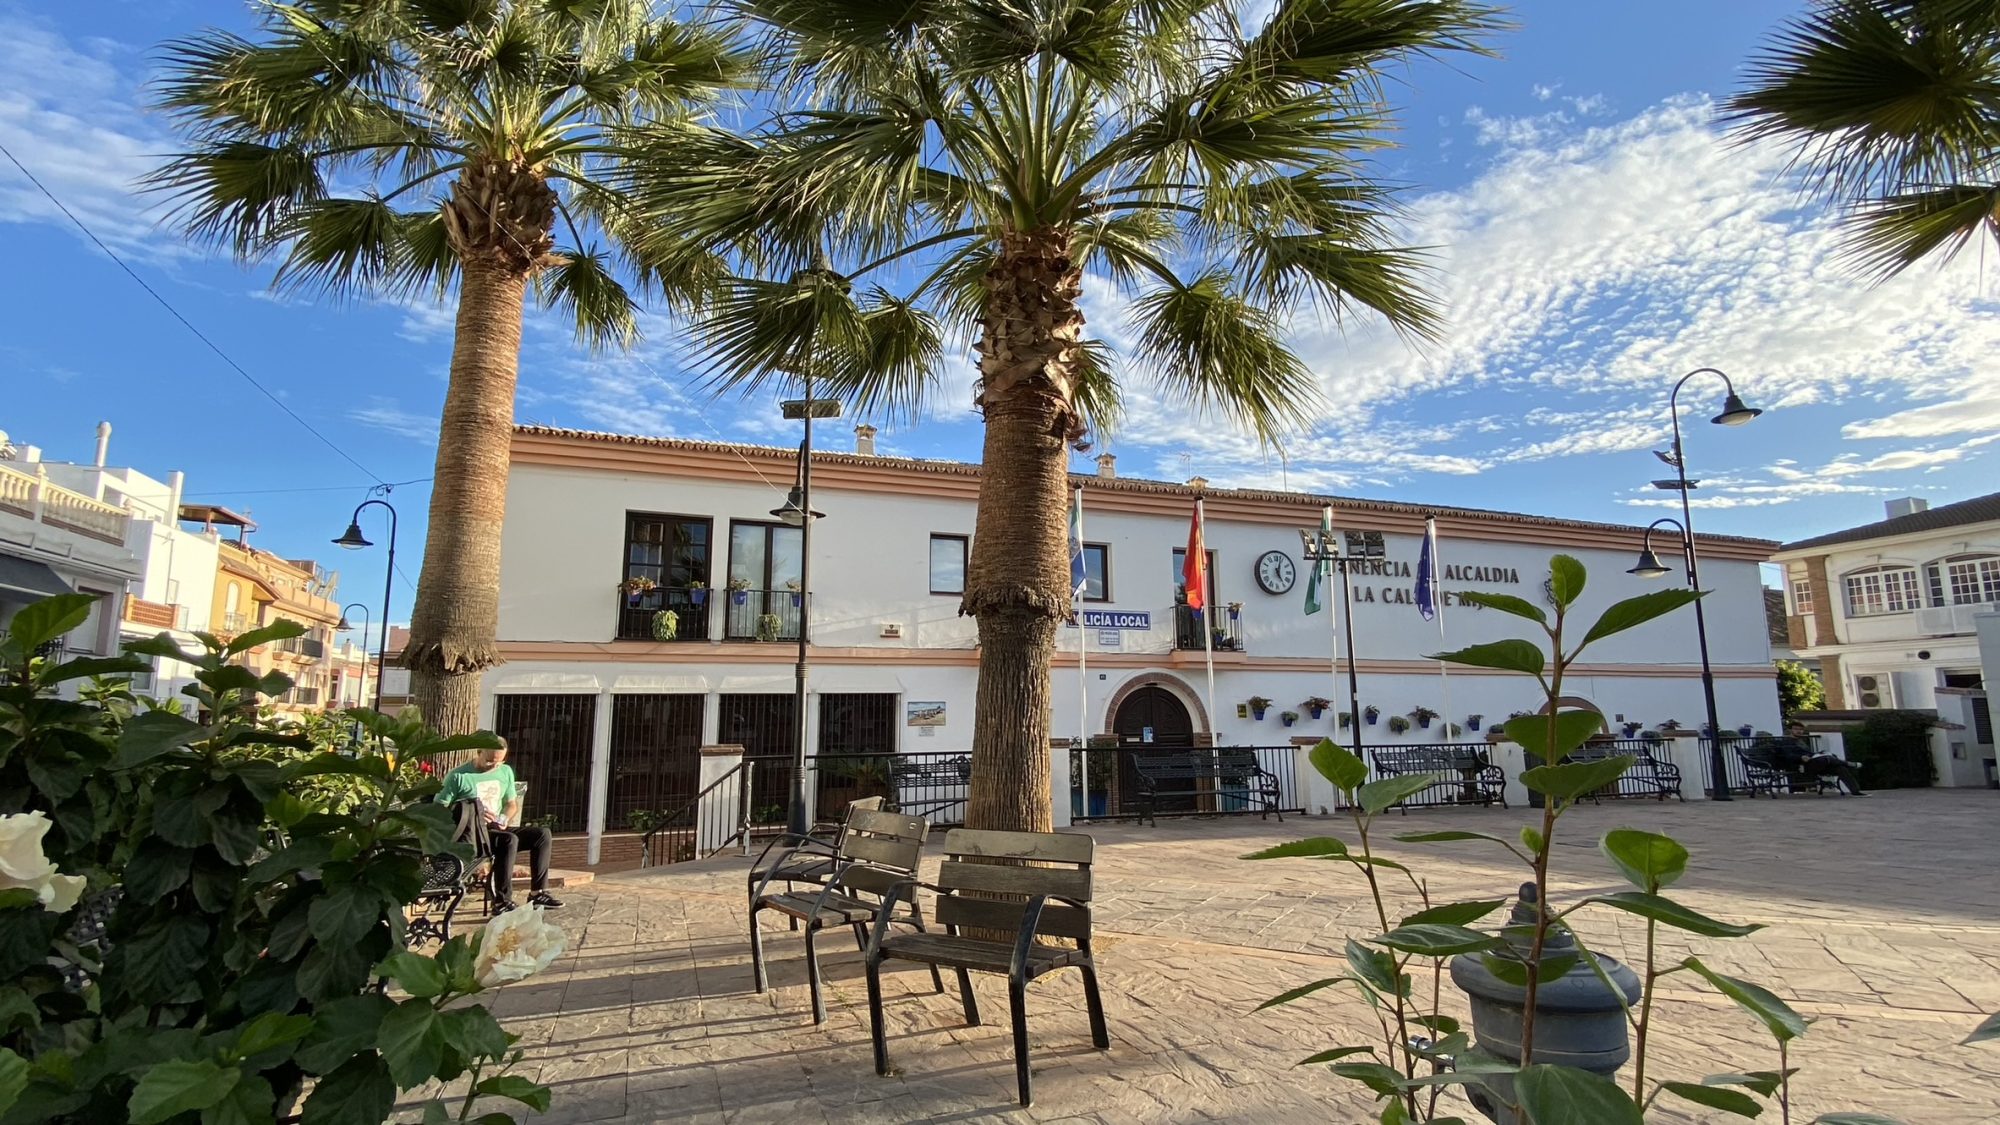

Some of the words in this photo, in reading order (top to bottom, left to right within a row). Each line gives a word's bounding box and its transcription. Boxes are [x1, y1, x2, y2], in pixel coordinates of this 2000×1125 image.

[1445, 564, 1520, 584] ALCALDIA
[1353, 586, 1375, 603] LA
[1382, 588, 1417, 605] CAL
[1114, 615, 1148, 627] LOCAL
